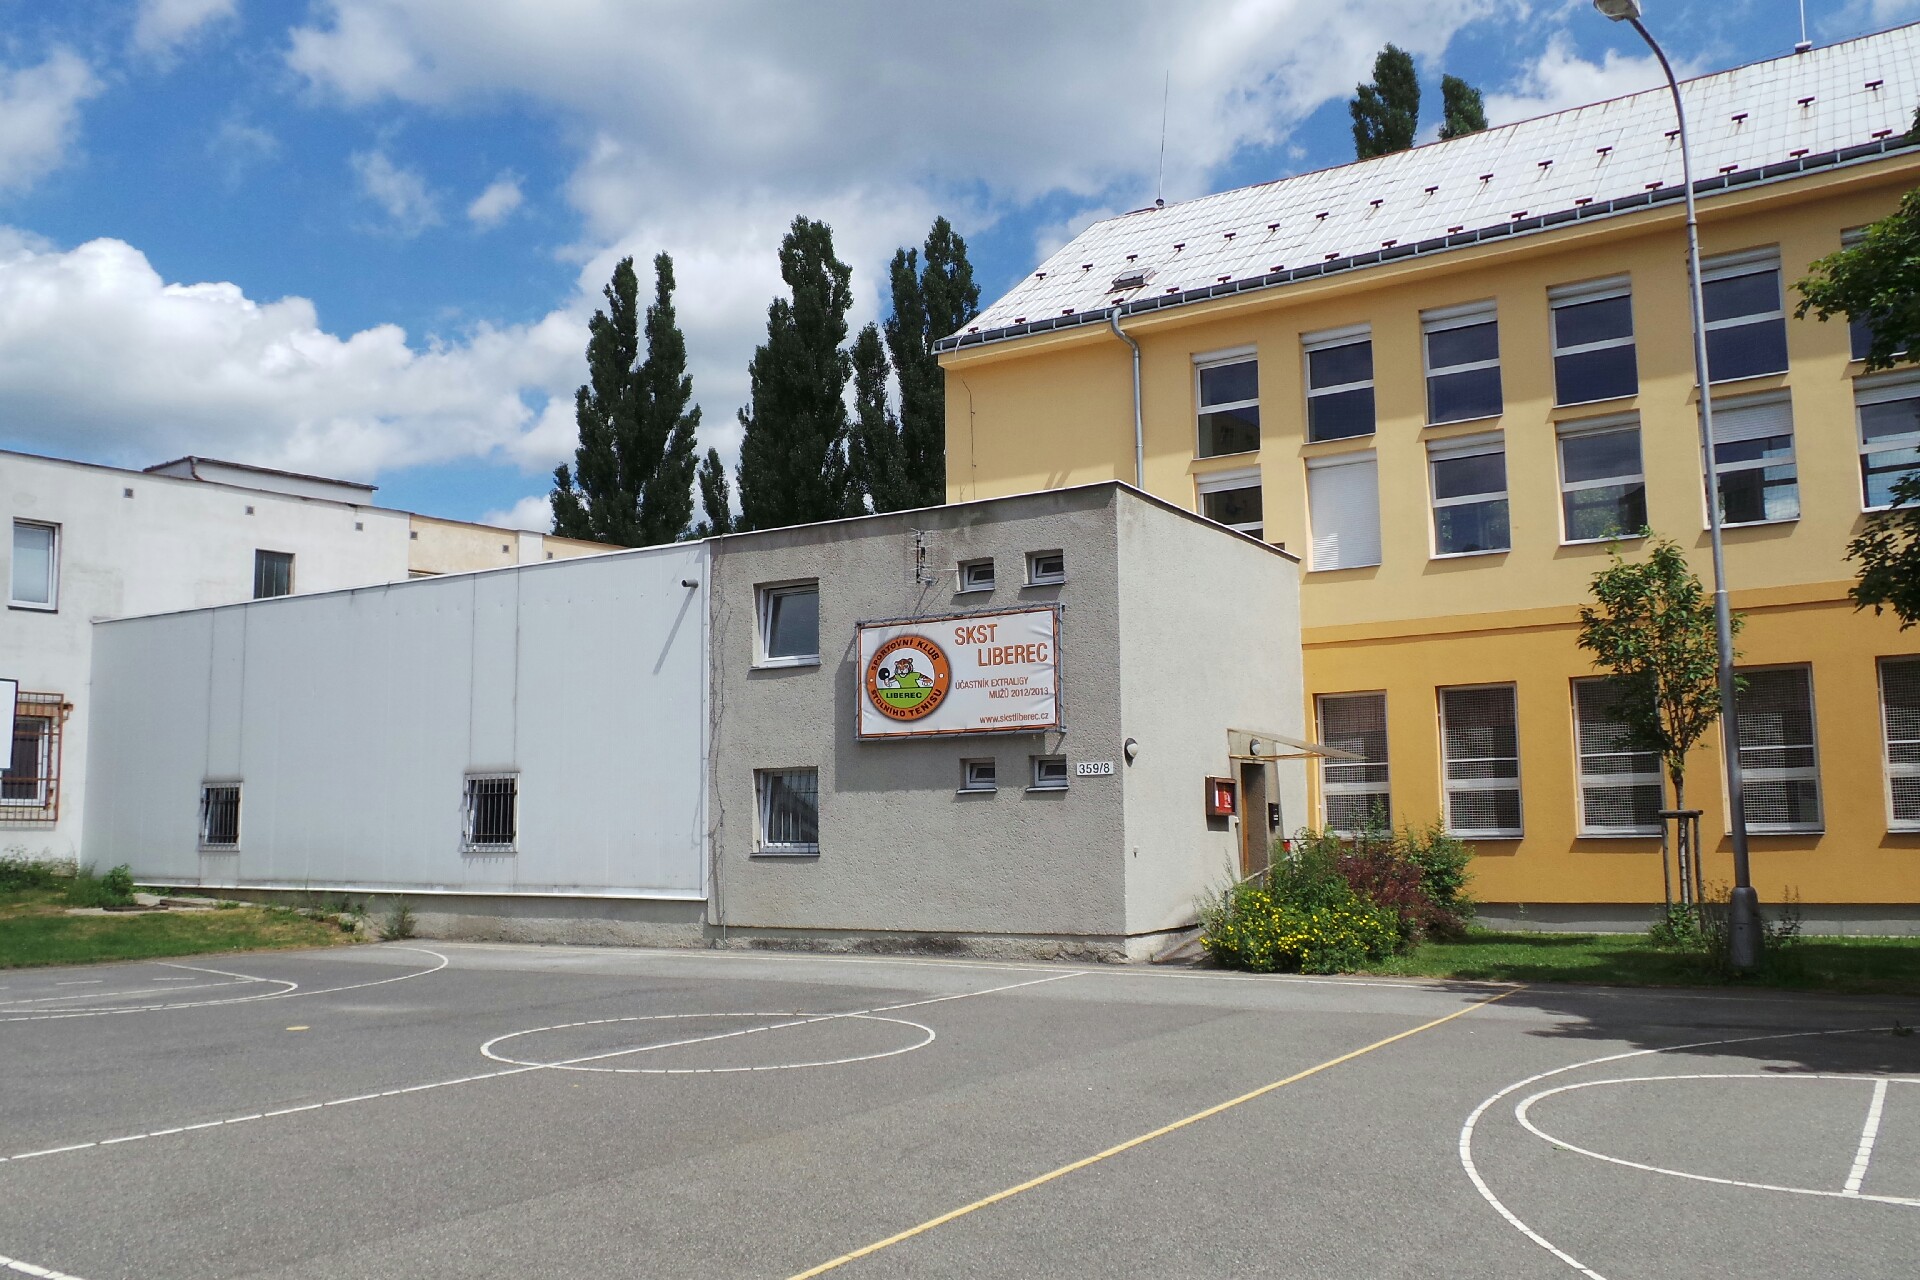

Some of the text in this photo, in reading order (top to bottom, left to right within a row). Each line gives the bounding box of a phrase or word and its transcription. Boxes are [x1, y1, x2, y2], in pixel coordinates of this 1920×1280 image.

[954, 623, 998, 646] SKST
[871, 638, 940, 671] SPORTOVNÍ KLUB
[977, 642, 1048, 667] LIBEREC
[955, 676, 1029, 690] ÚČASTNÍK EXTRALIGY
[1011, 686, 1049, 697] 2012/2013
[908, 689, 943, 716] TENISU
[979, 712, 1049, 724] www.skstliberec.cz
[1079, 762, 1110, 774] 359/8
